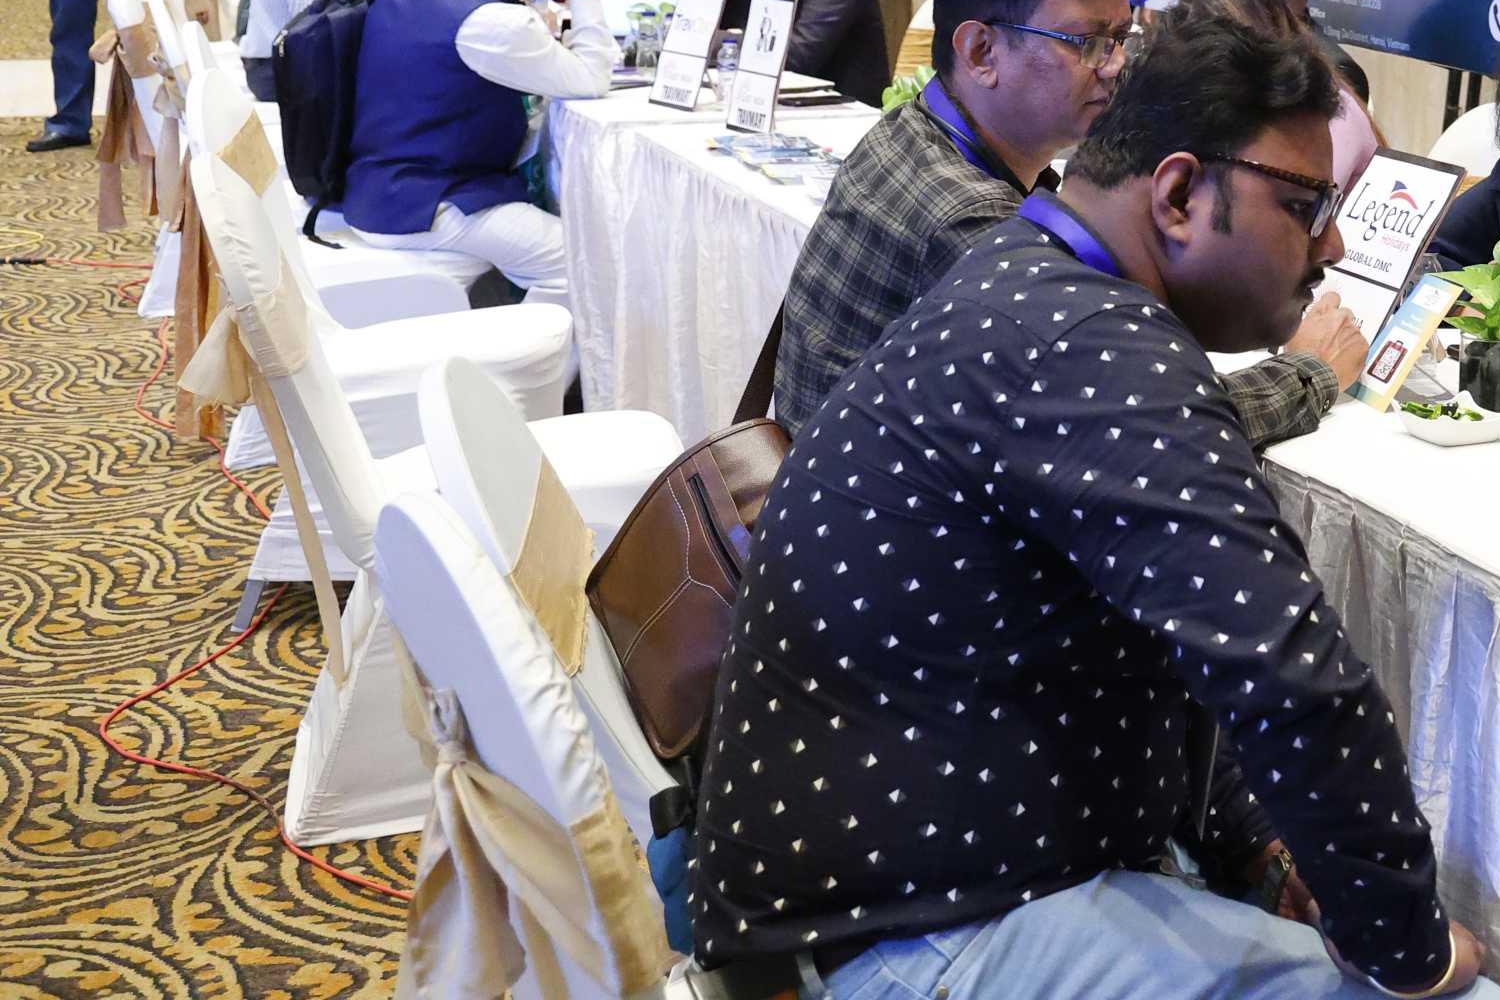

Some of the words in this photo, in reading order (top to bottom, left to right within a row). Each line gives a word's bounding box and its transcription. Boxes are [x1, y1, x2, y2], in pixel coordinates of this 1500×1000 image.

[1346, 182, 1435, 241] Legend
[1345, 249, 1373, 268] GLOBAL
[1373, 260, 1392, 272] DMC
